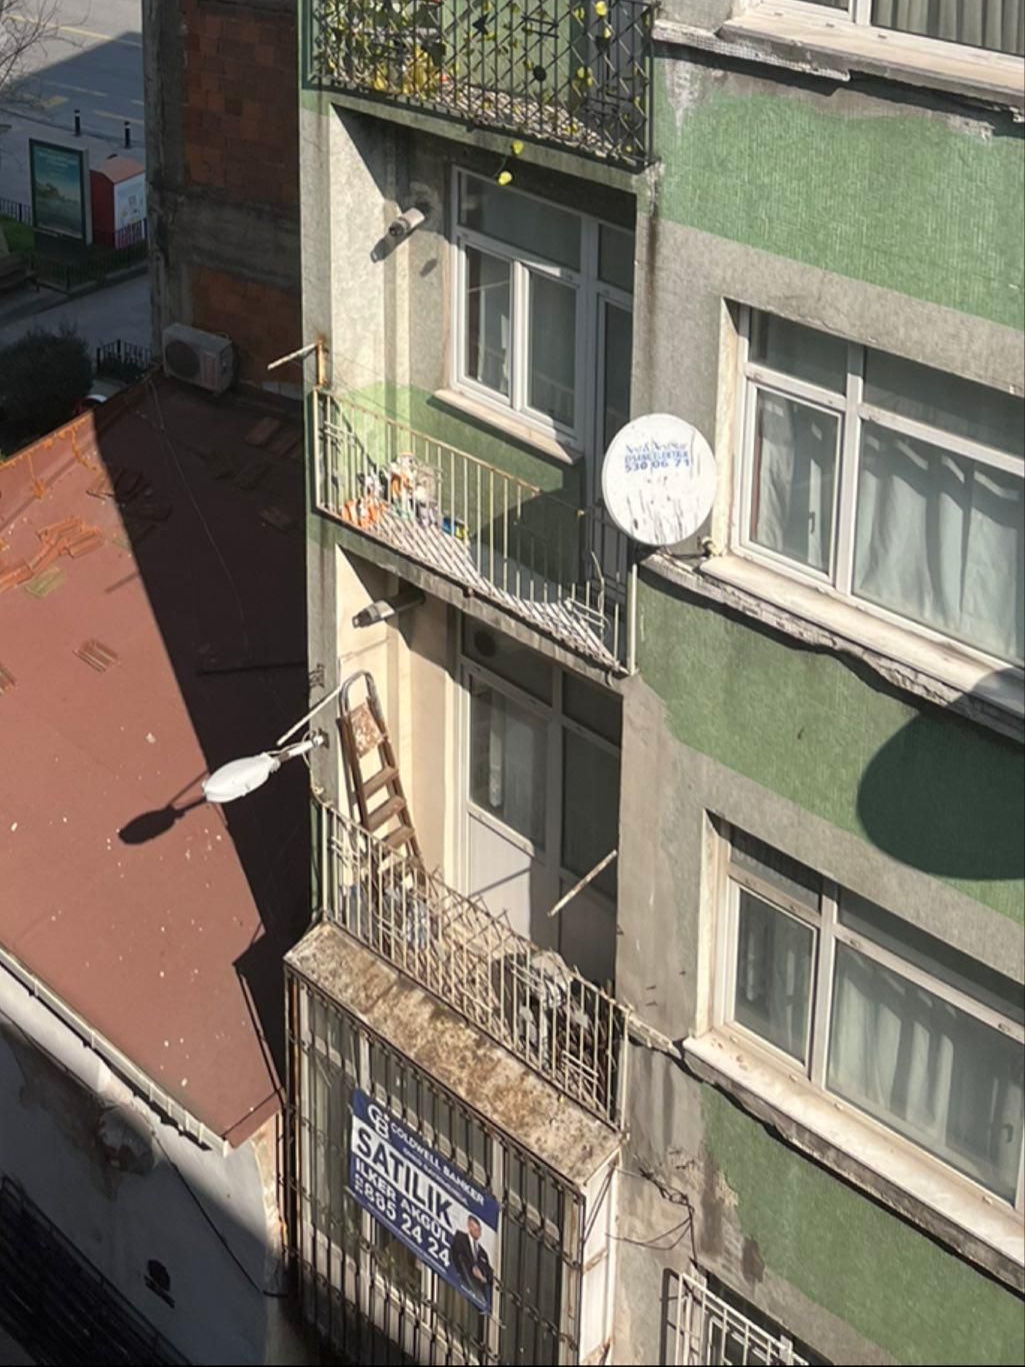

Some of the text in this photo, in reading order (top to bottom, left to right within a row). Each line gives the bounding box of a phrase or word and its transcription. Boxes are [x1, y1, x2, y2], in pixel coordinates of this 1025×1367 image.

[356, 1127, 455, 1228] SATILIK
[390, 1121, 442, 1169] COLDWELL
[443, 1163, 485, 1206] BANKER
[401, 1214, 423, 1244] 24
[428, 1238, 451, 1268] 24
